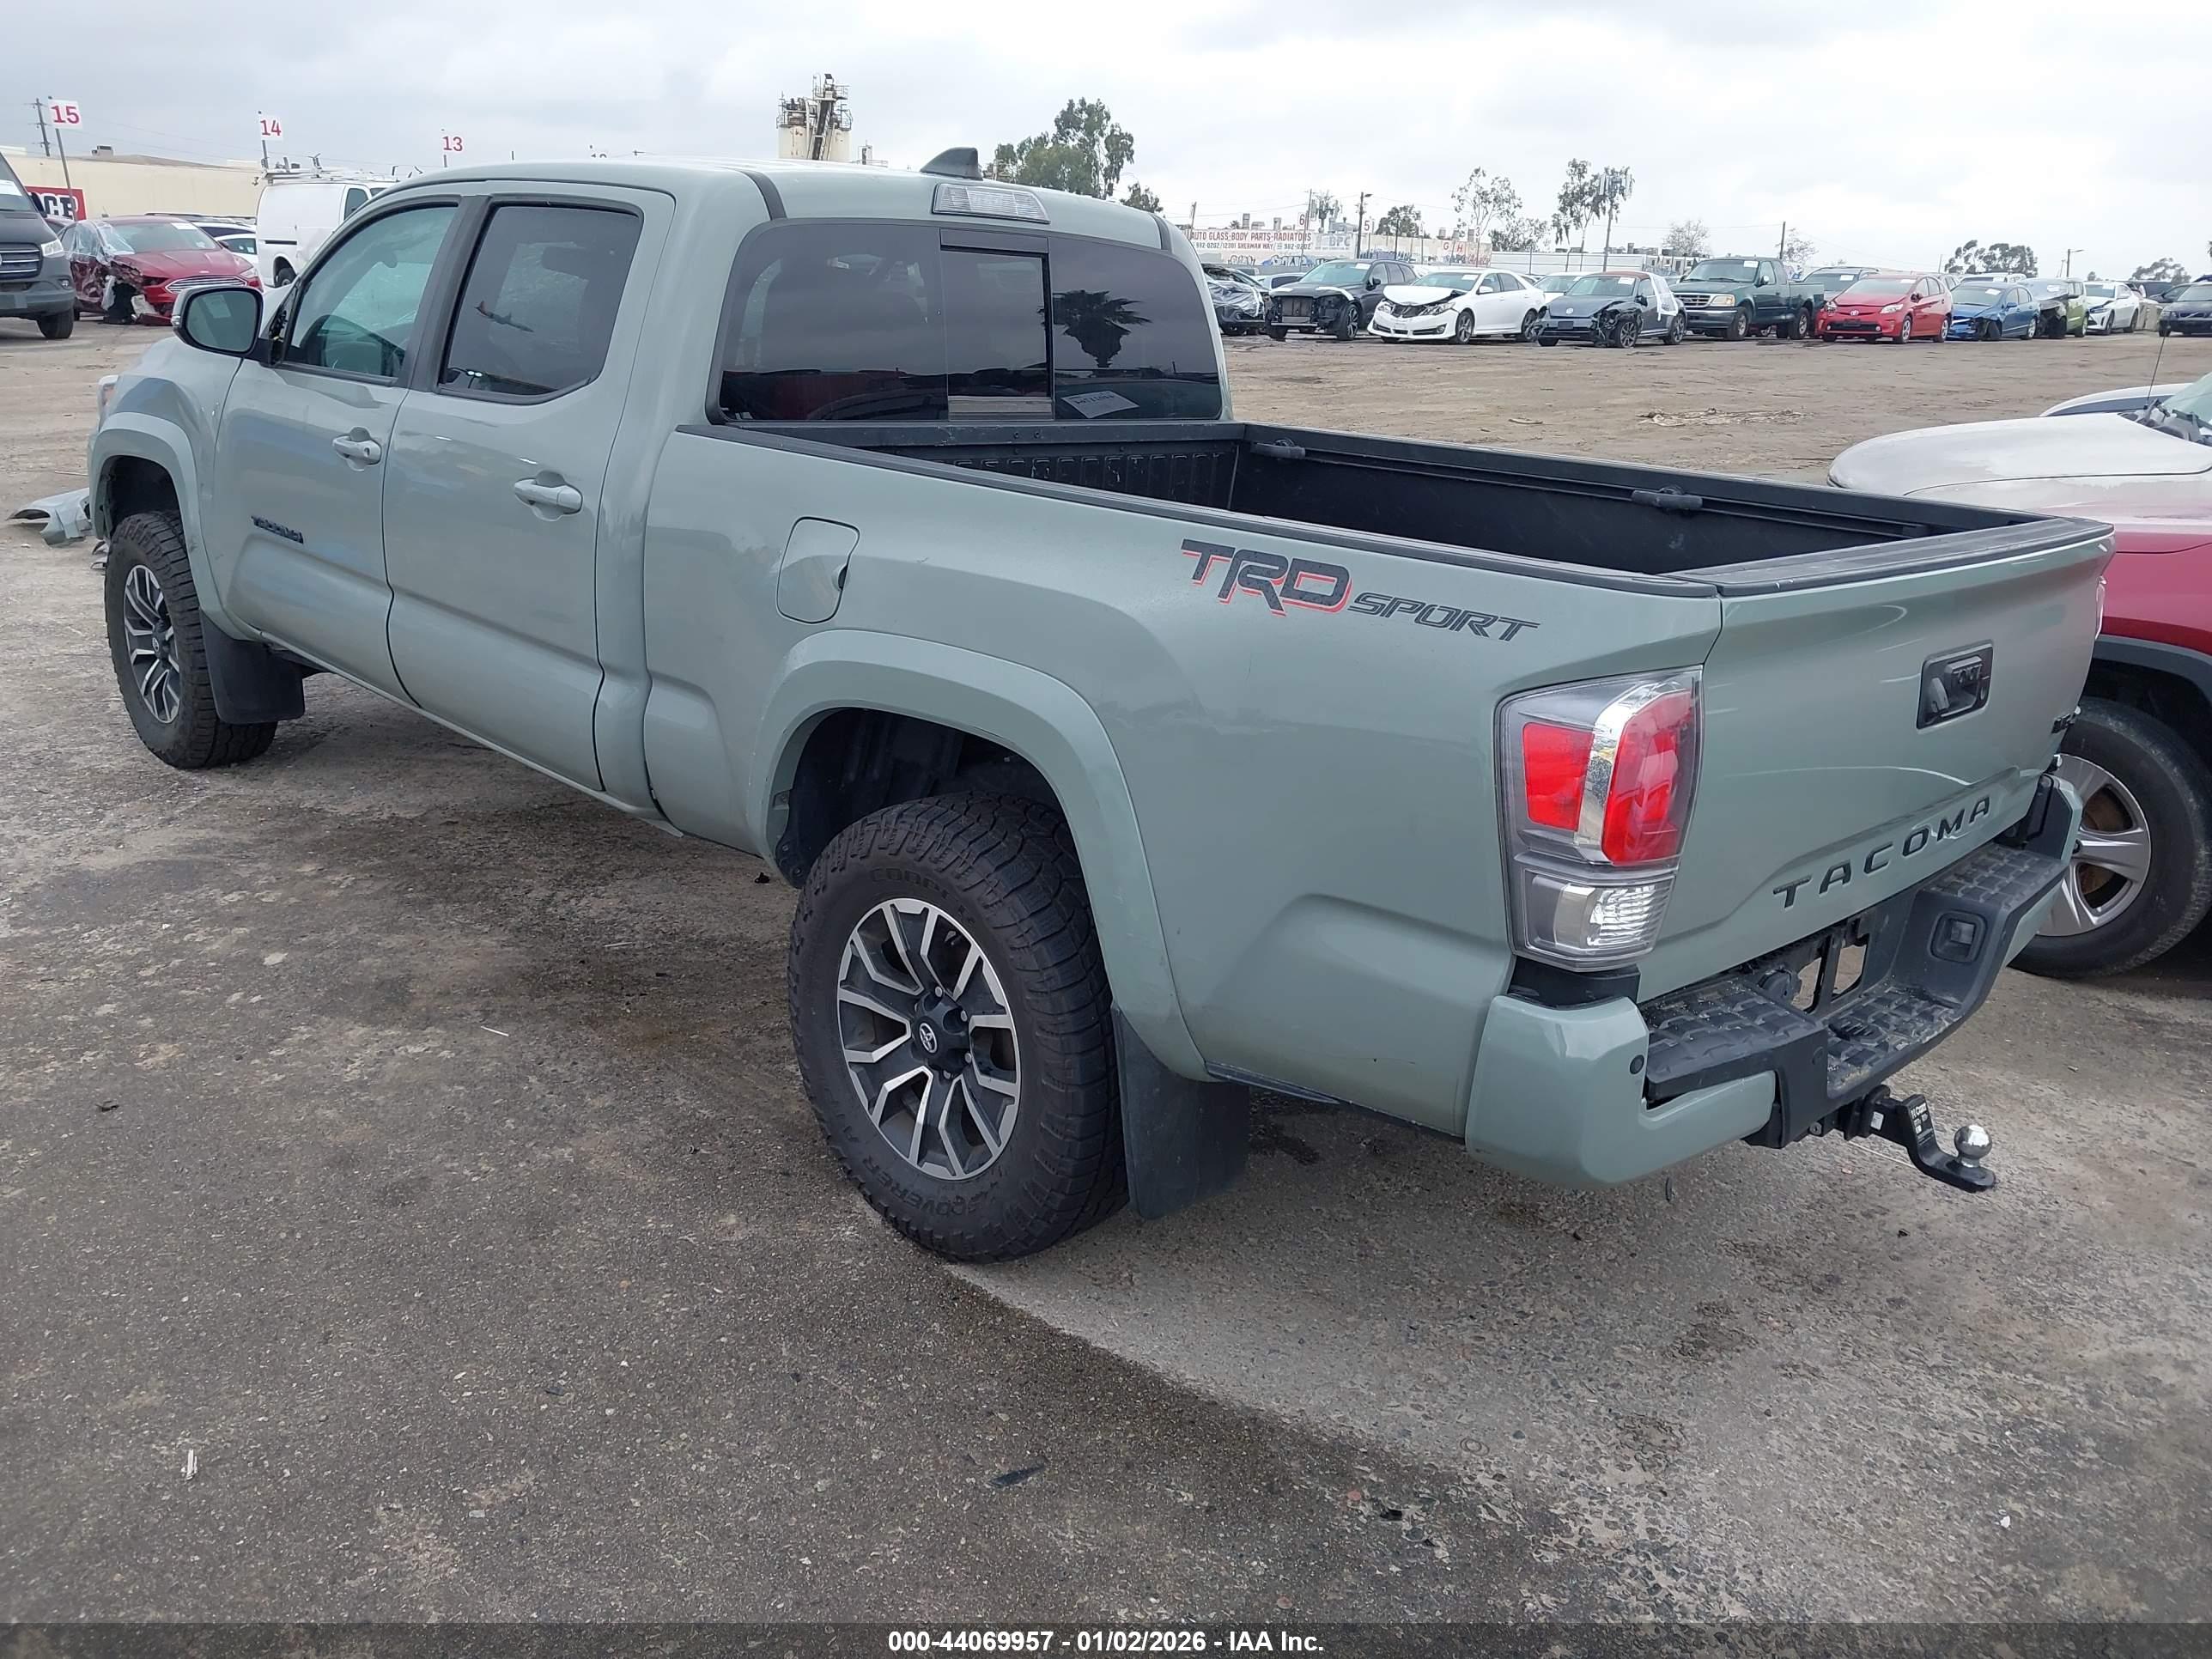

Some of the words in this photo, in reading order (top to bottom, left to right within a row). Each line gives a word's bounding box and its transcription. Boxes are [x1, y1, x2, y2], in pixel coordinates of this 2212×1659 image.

[51, 105, 81, 125] 15
[259, 118, 283, 137] 14
[441, 136, 464, 152] 13
[1299, 213, 1305, 226] 6
[1364, 220, 1370, 231] 5
[1443, 241, 1449, 251] G
[1455, 243, 1464, 252] H
[1181, 538, 1353, 617] TRD
[1347, 591, 1541, 642] SPORT
[1772, 796, 1991, 908] TACOMA
